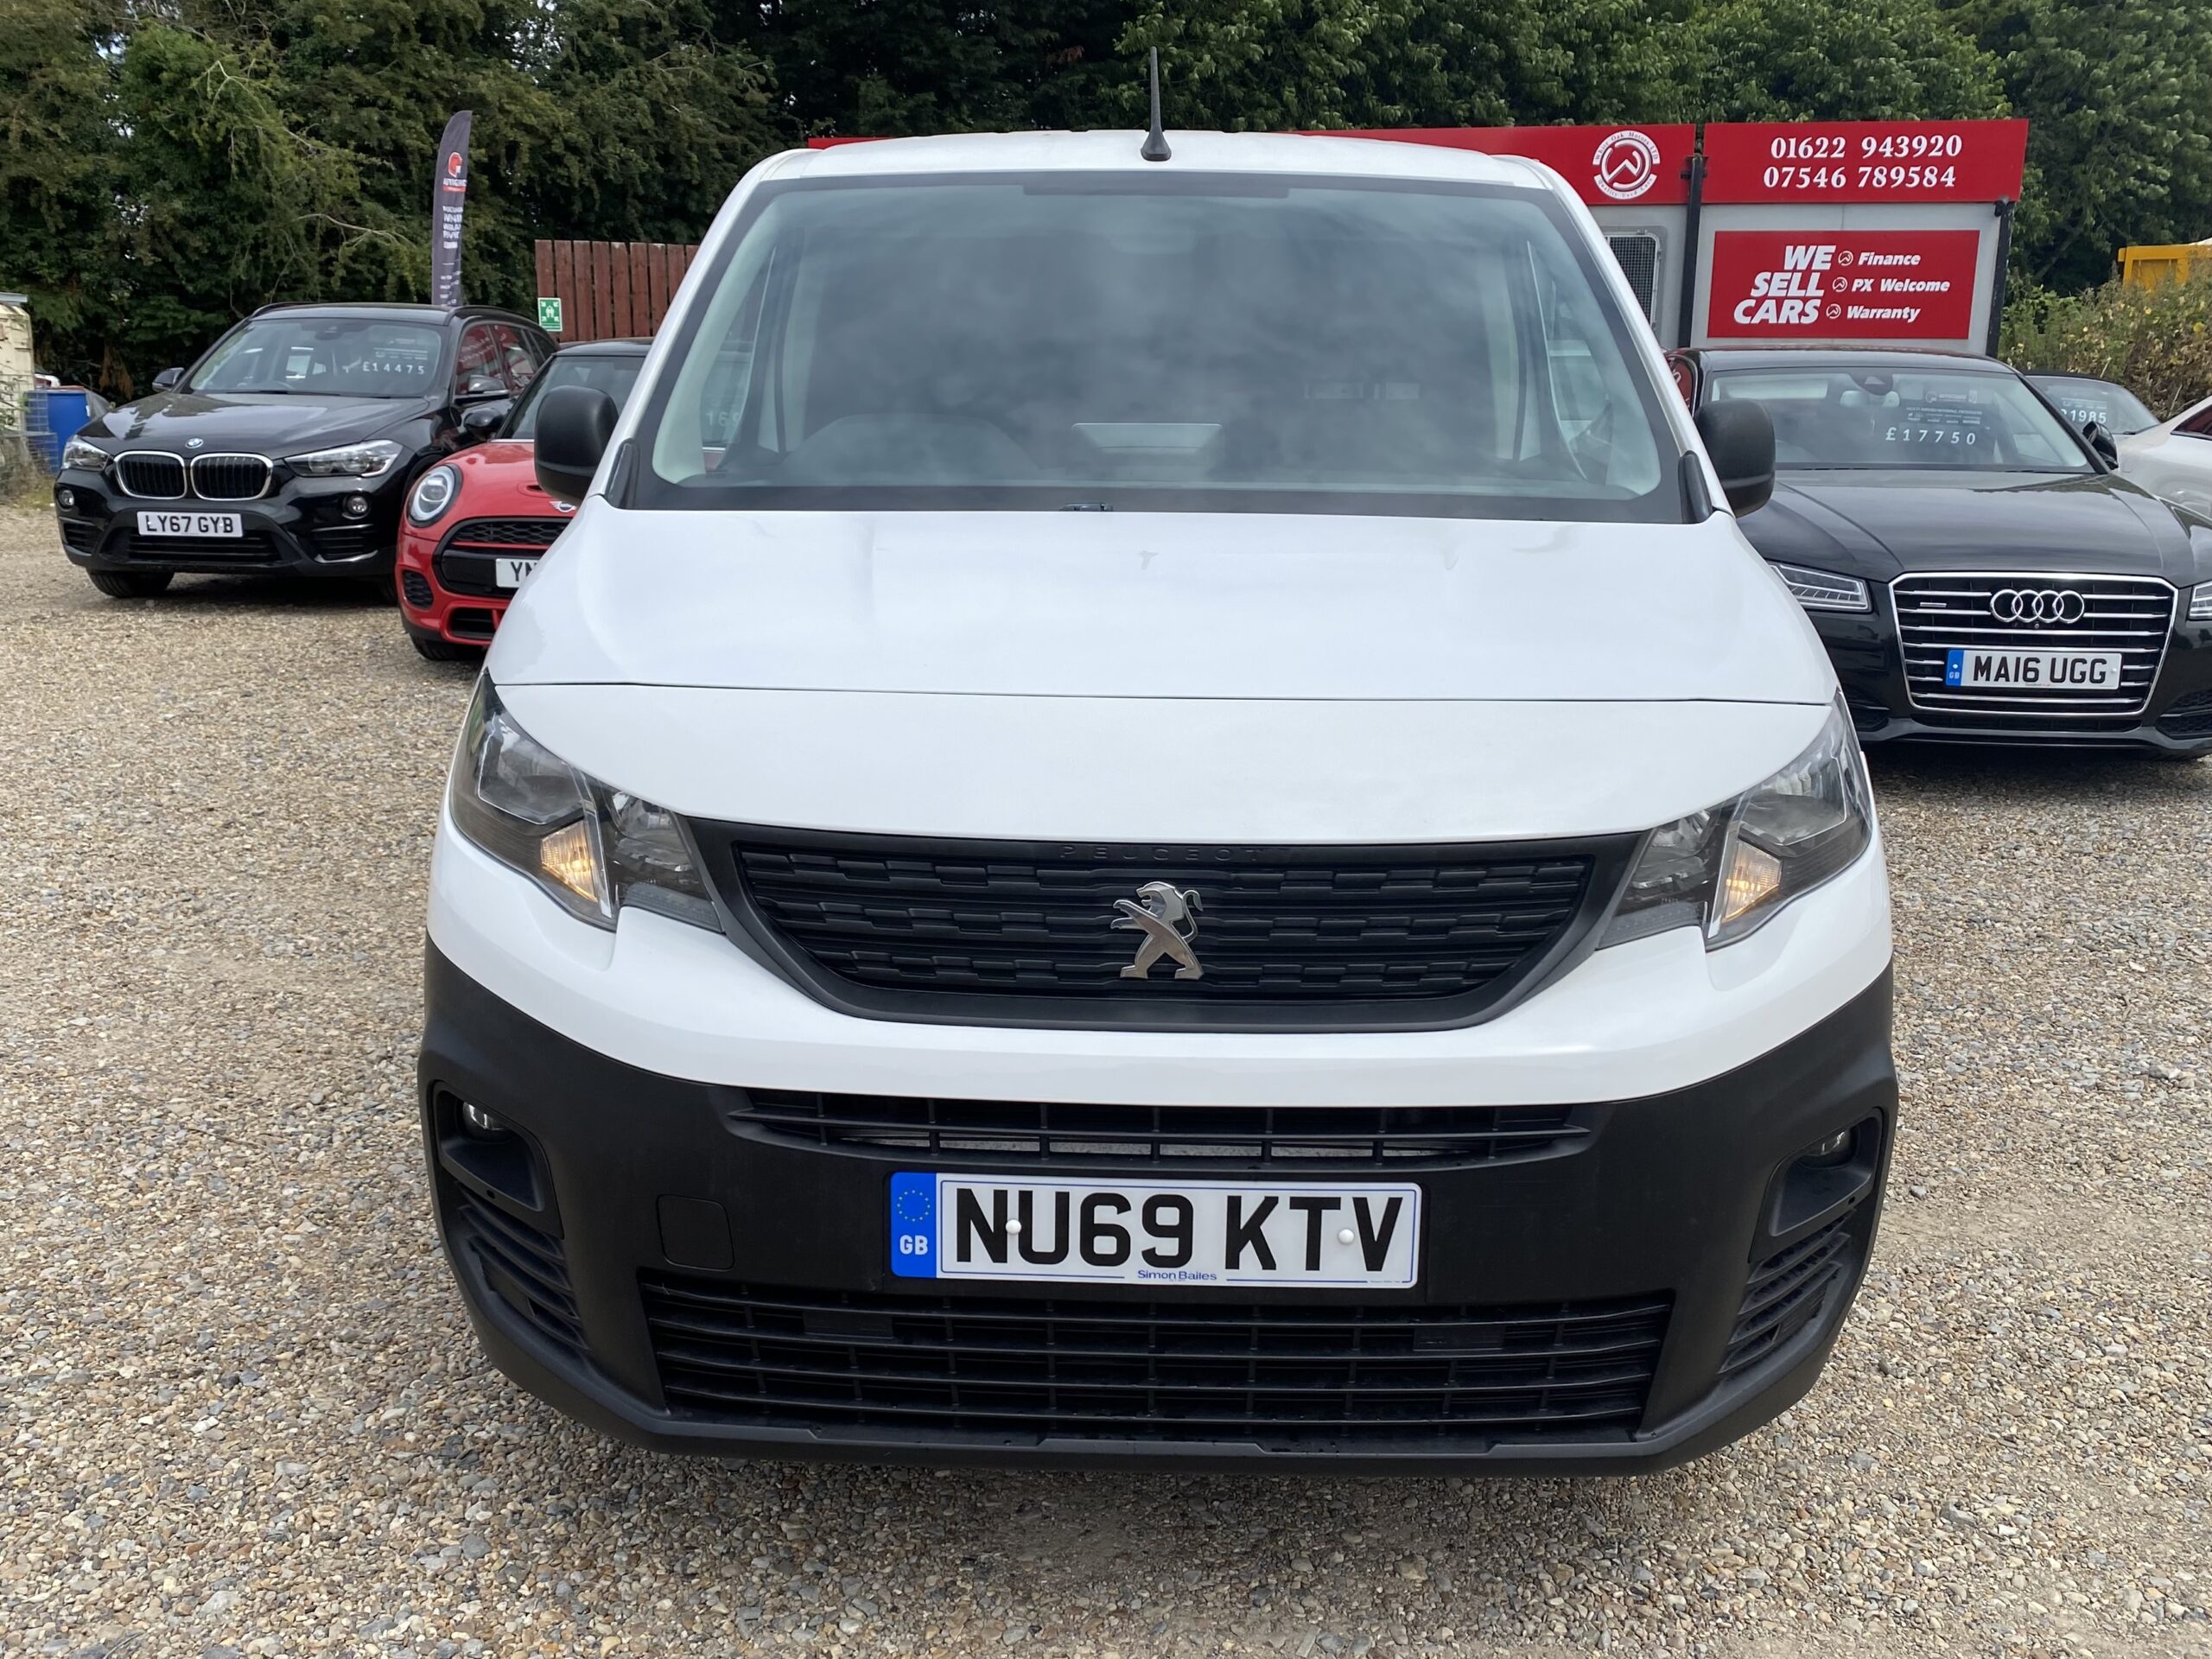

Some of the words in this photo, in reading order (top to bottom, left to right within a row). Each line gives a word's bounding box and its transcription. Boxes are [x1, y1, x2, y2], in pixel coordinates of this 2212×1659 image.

[1595, 141, 1610, 161] White
[1628, 131, 1649, 145] Motors
[1649, 145, 1658, 160] LTD
[1770, 137, 1846, 159] 01622
[1861, 134, 1962, 159] 943920
[1763, 166, 1847, 189] 07546
[1858, 165, 1956, 188] 789584
[1783, 245, 1836, 270] WE
[1858, 251, 1922, 266] Finance
[1750, 271, 1825, 298] SELL
[1851, 278, 1875, 292] PX
[1879, 278, 1951, 292] Welcome
[1733, 298, 1821, 325] CARS
[1847, 305, 1922, 323] Warranty
[362, 361, 425, 375] £14475
[1885, 426, 1976, 446] £17750
[145, 515, 192, 532] LY67
[198, 517, 233, 533] GYB
[1973, 655, 2041, 683] MA16
[2050, 658, 2107, 684] UGG
[1059, 845, 1263, 862] PEUGEOT
[956, 1188, 1194, 1268] NU69
[1224, 1195, 1403, 1272] KTV
[899, 1235, 928, 1255] GB
[1137, 1269, 1177, 1280] Simon
[1178, 1270, 1217, 1281] Bailes
